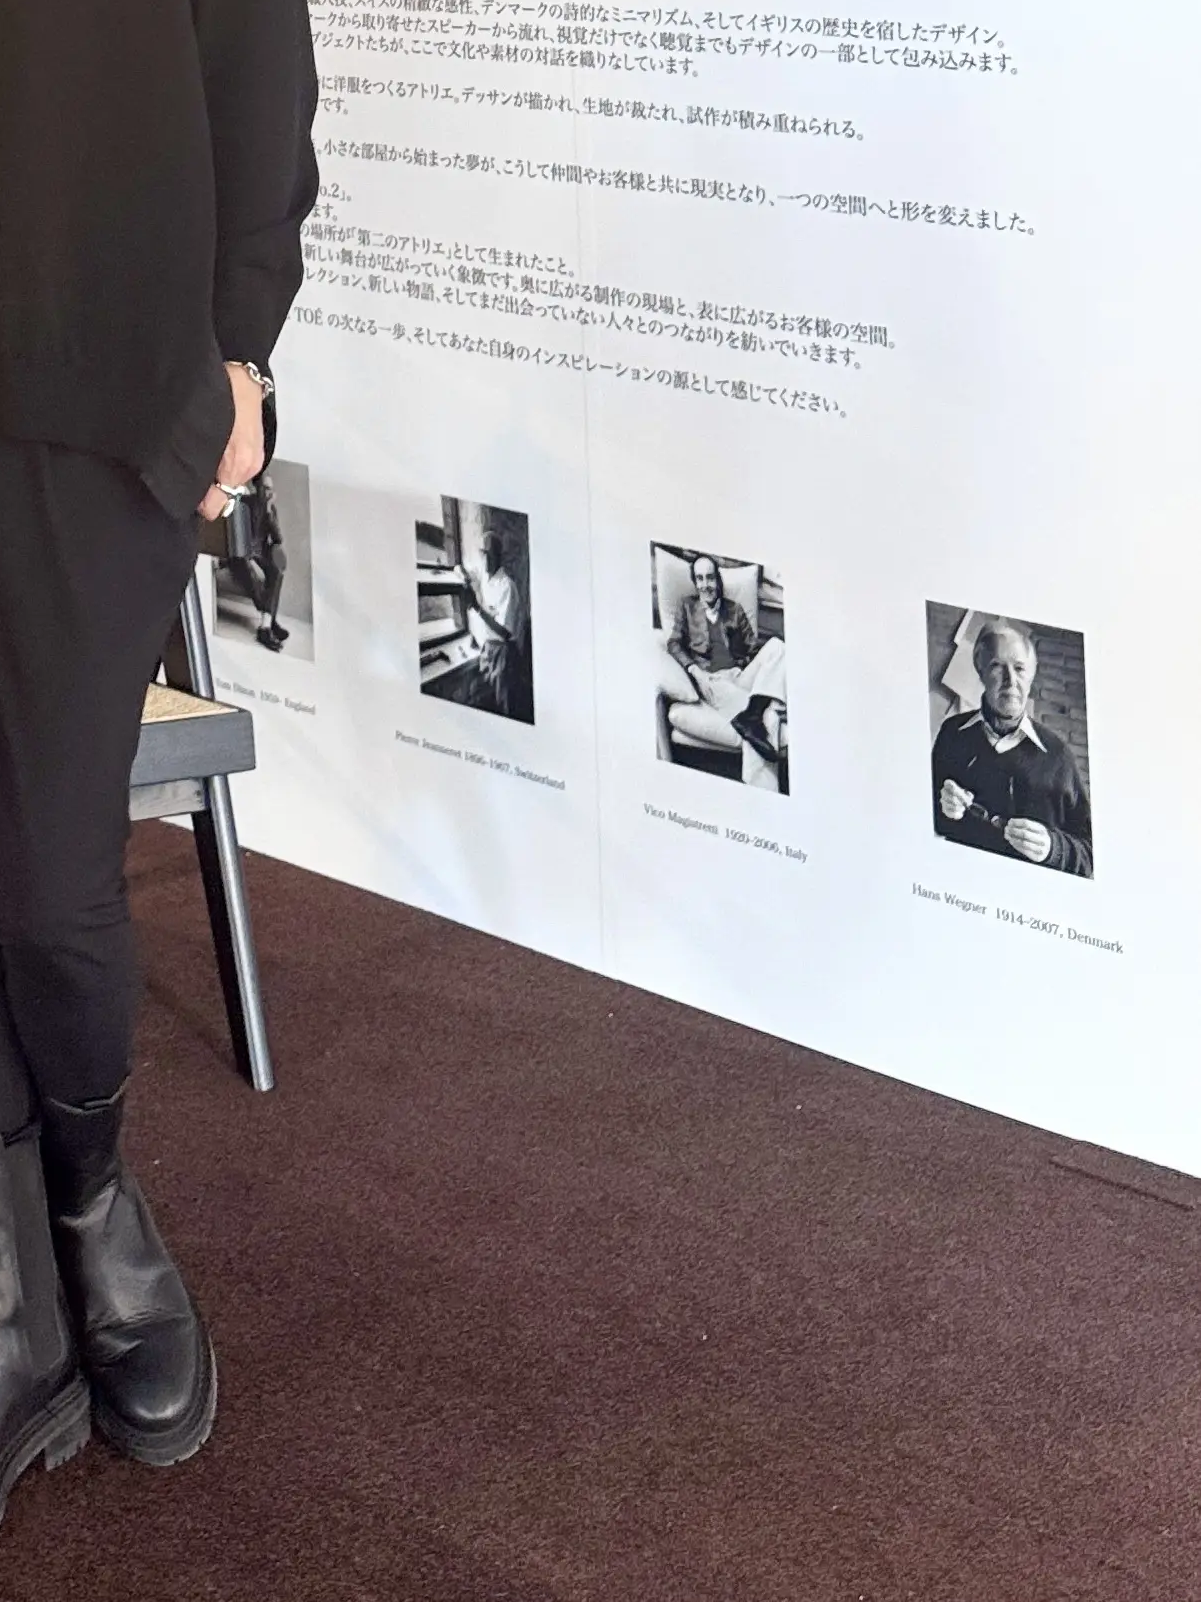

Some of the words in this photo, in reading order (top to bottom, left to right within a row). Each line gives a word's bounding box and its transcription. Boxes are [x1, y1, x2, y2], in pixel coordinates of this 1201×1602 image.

[309, 11, 1018, 76] ークから取り寄せたスピーカーから流れ、視覚だけでなく聴覚までもデザインの一部として包み込みます。
[317, 74, 864, 142] に洋服をつくるアトリエ。デッサンが描かれ、生地が裁たれ、試作が積み重ねられる。
[320, 96, 349, 116] です。
[312, 198, 338, 223] ます。
[294, 306, 324, 327] TOÉ
[912, 882, 941, 903] Hans
[944, 891, 987, 917] Wegner
[1066, 926, 1124, 955] Denmark
